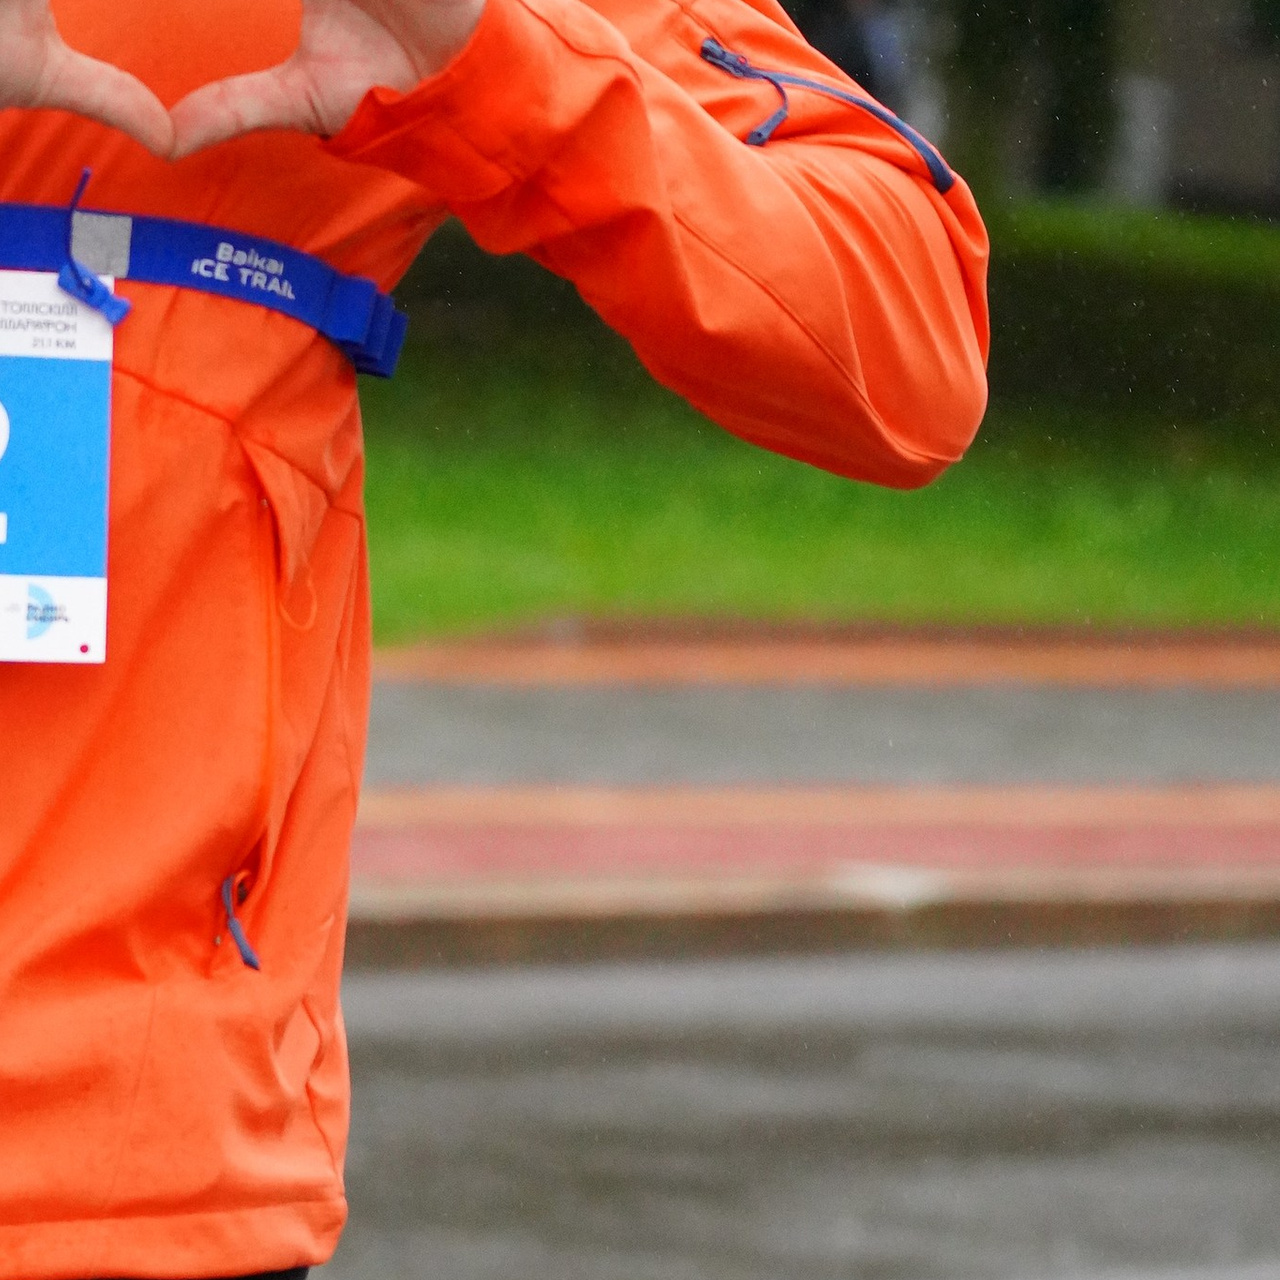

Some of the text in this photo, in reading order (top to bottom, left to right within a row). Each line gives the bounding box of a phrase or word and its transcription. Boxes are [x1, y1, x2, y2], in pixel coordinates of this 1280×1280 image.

[216, 241, 284, 276] Baikal
[191, 258, 296, 300] ICE TRAIL
